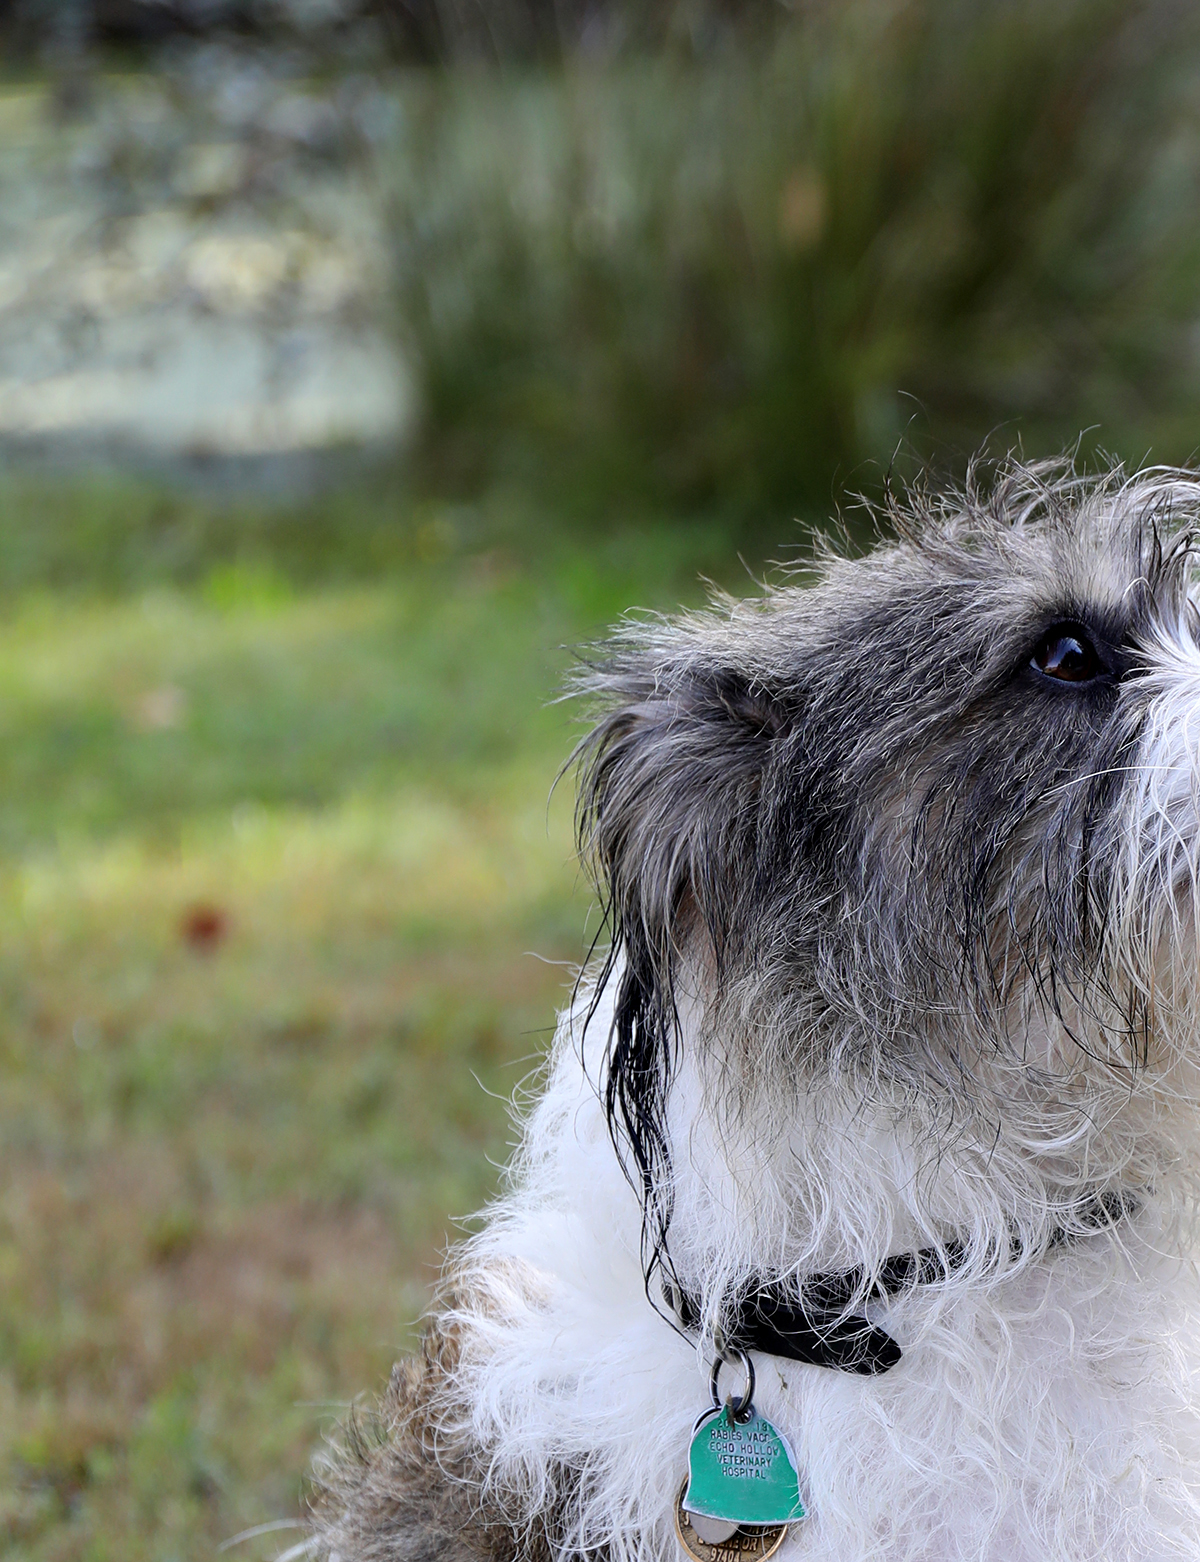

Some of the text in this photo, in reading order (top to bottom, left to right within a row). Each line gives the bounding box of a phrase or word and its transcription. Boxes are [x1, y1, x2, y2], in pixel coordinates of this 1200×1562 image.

[710, 1429, 742, 1441] RABIES
[709, 1441, 779, 1456] ECHO HOLLOW
[717, 1454, 772, 1467] VETERINARY
[722, 1466, 766, 1479] HOSPITAL
[742, 1536, 758, 1551] OR
